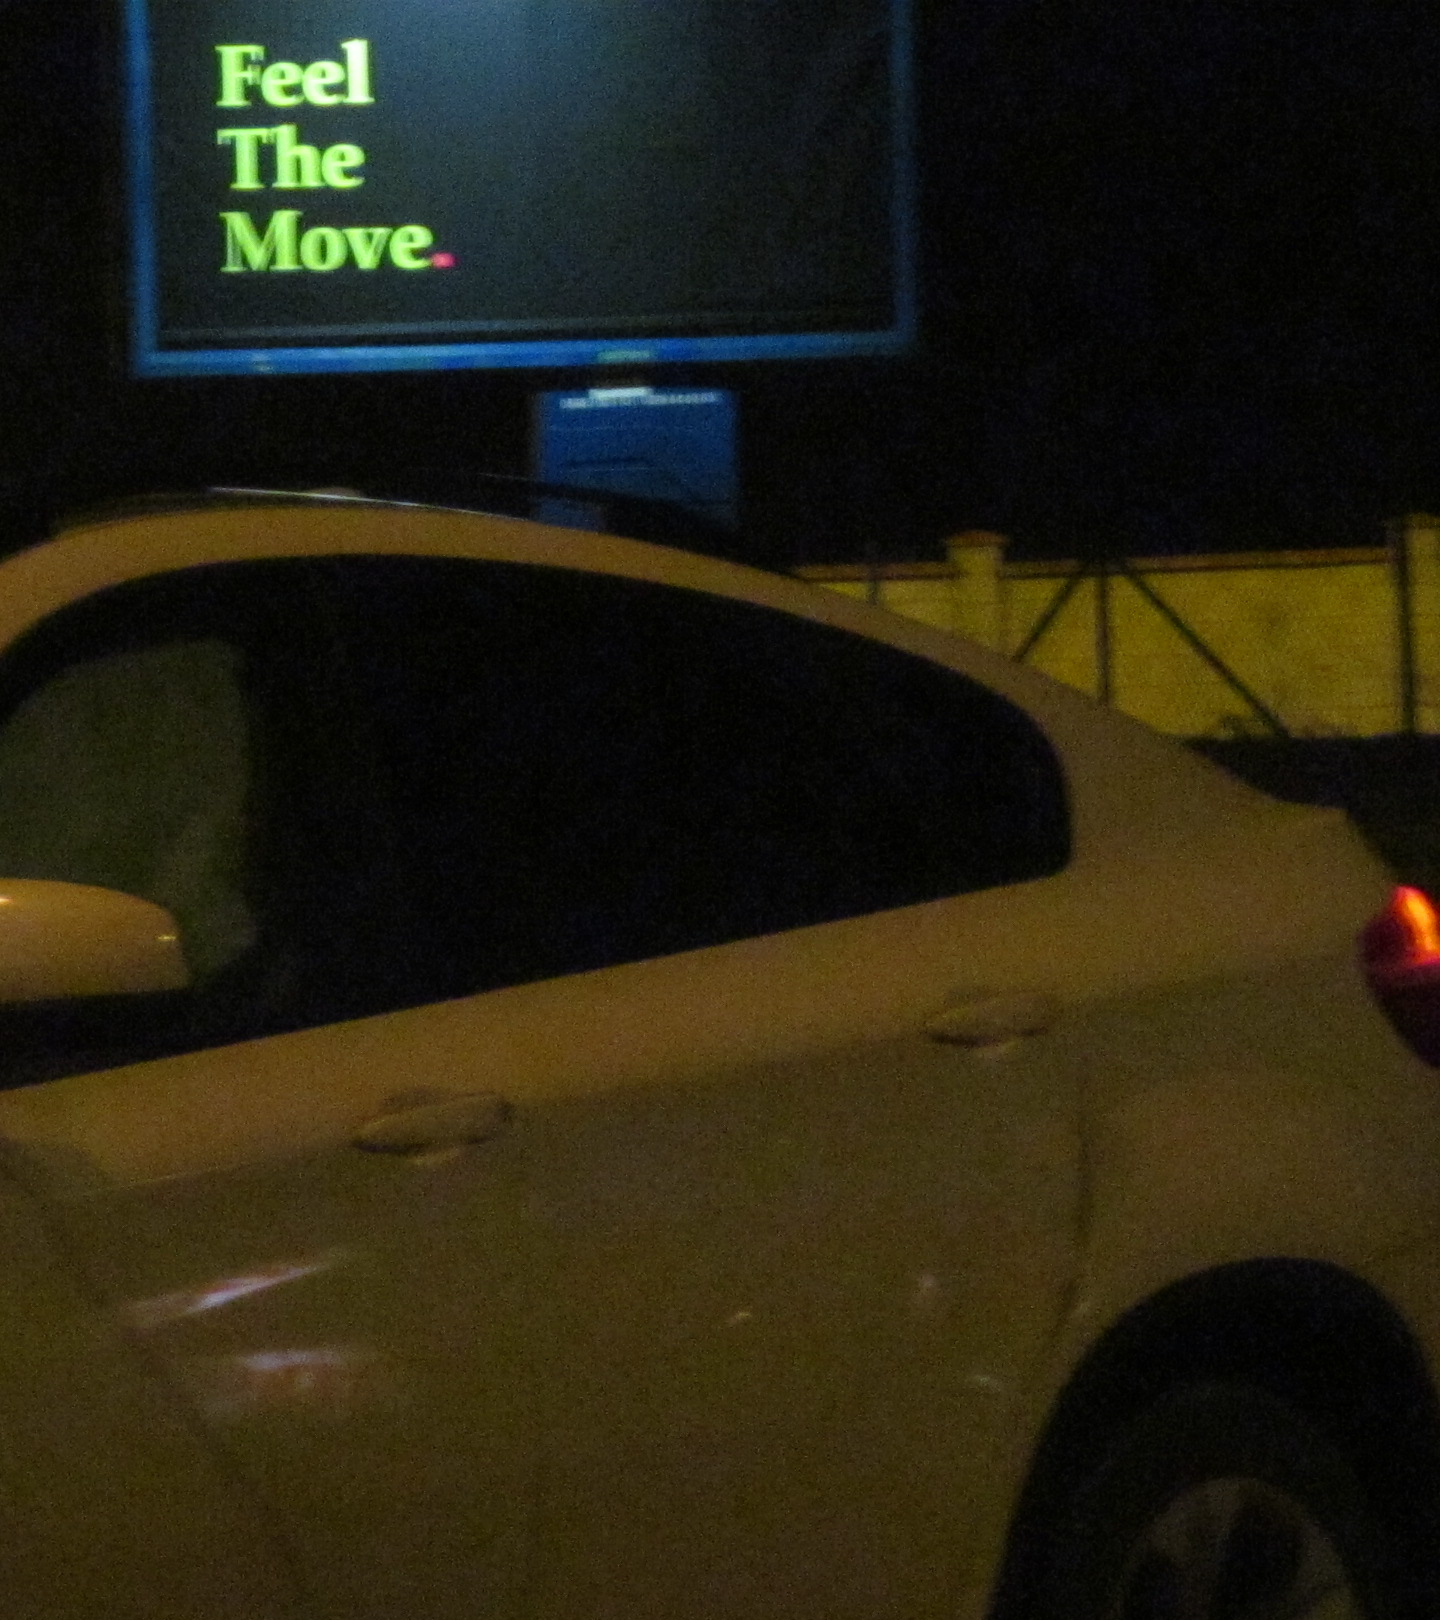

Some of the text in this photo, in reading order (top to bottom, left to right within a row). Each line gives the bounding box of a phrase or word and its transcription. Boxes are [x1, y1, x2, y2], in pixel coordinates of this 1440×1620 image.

[214, 37, 377, 109] Feel
[216, 123, 367, 191] The
[219, 209, 458, 274] Move.
